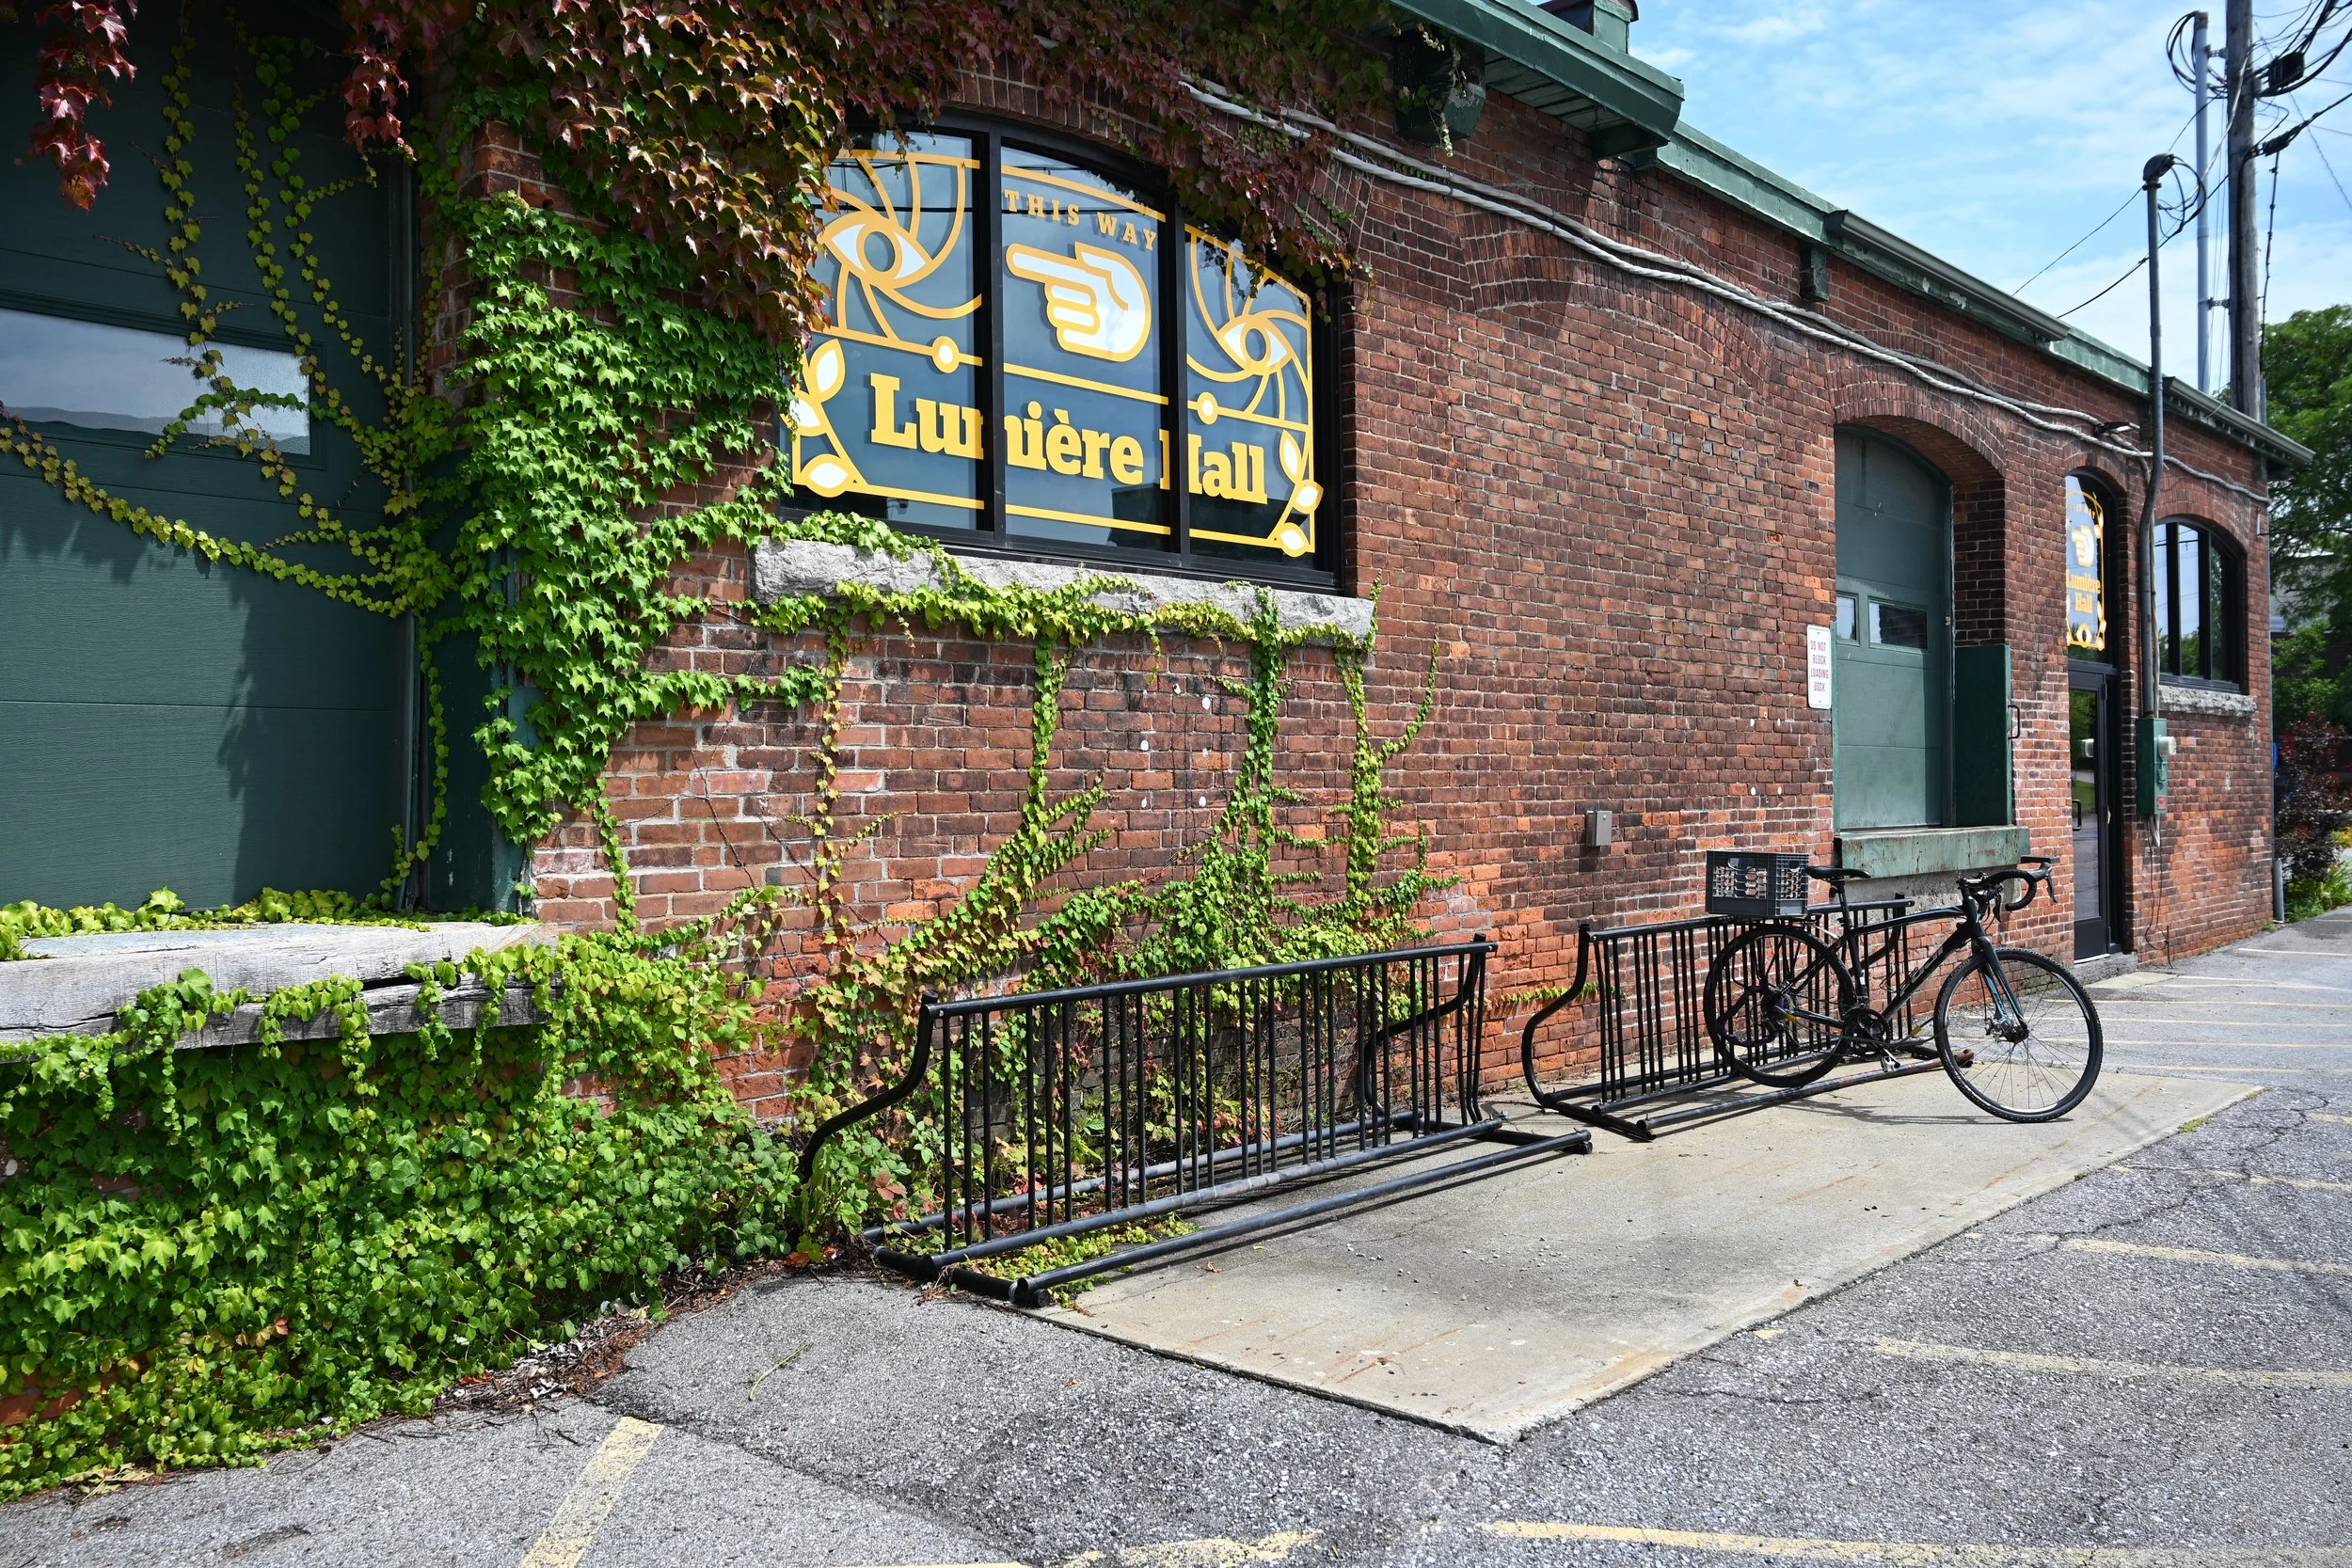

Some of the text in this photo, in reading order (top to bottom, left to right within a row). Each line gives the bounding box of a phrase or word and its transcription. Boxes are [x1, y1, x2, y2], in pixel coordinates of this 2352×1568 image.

[1005, 189, 1157, 250] THIS WAY
[2075, 591, 2092, 613] Hall
[1810, 640, 1826, 652] DO NOT
[1812, 655, 1826, 665] BLOCK
[1810, 667, 1829, 679] LOADING
[1814, 681, 1826, 692] DOCK
